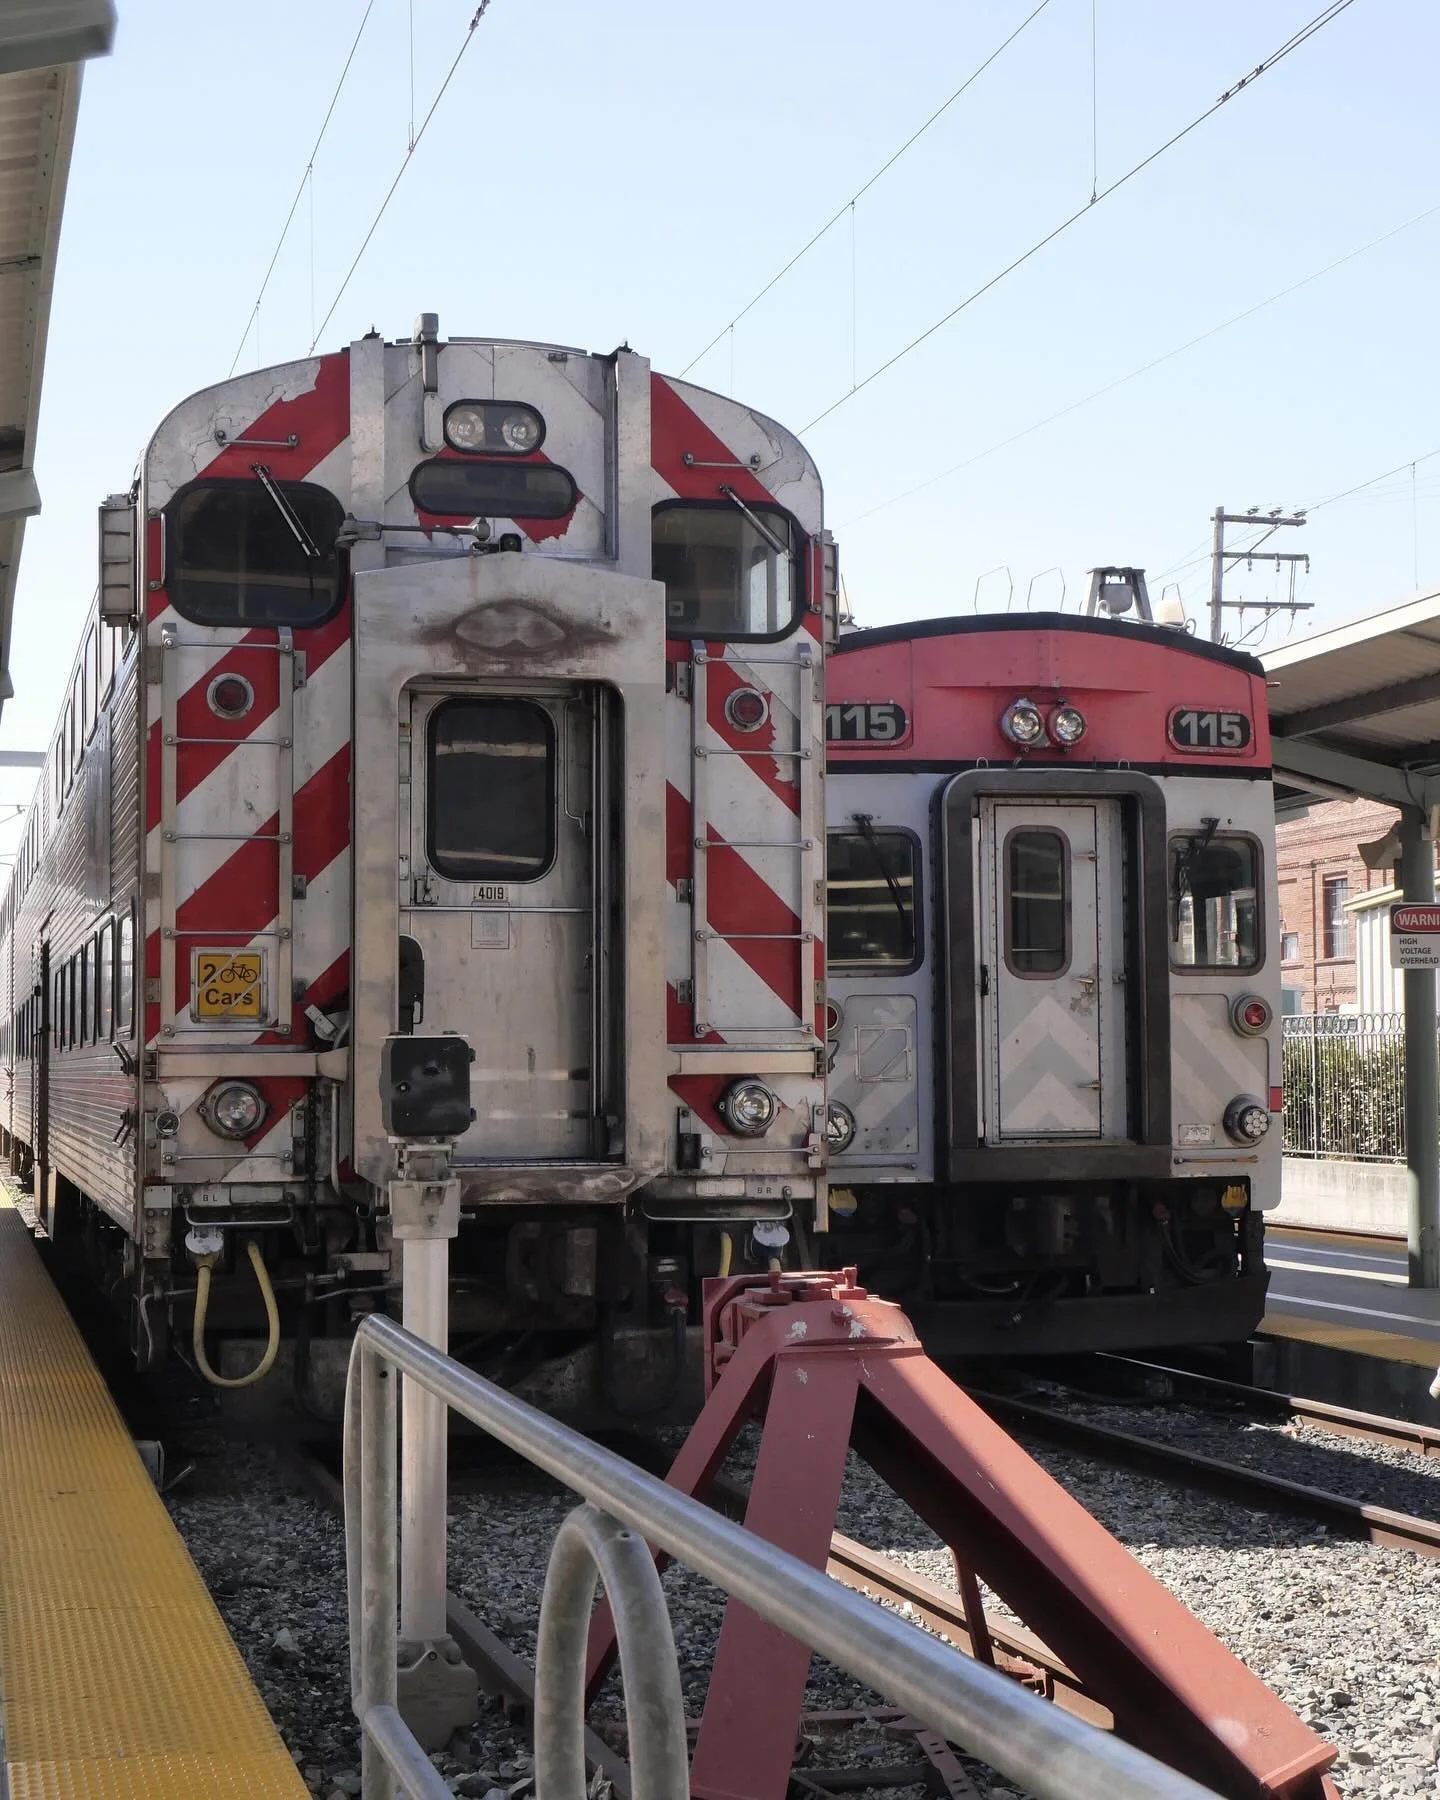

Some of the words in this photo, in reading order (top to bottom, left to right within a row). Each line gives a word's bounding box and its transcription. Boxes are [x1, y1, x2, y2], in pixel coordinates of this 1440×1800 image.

[825, 705, 897, 740] 115
[1179, 712, 1242, 747] 115
[478, 886, 504, 900] 4019
[1399, 937, 1418, 945] HIGH
[1399, 947, 1432, 955] VOLTAGE
[201, 963, 217, 984] 2
[205, 988, 253, 1006] Cars
